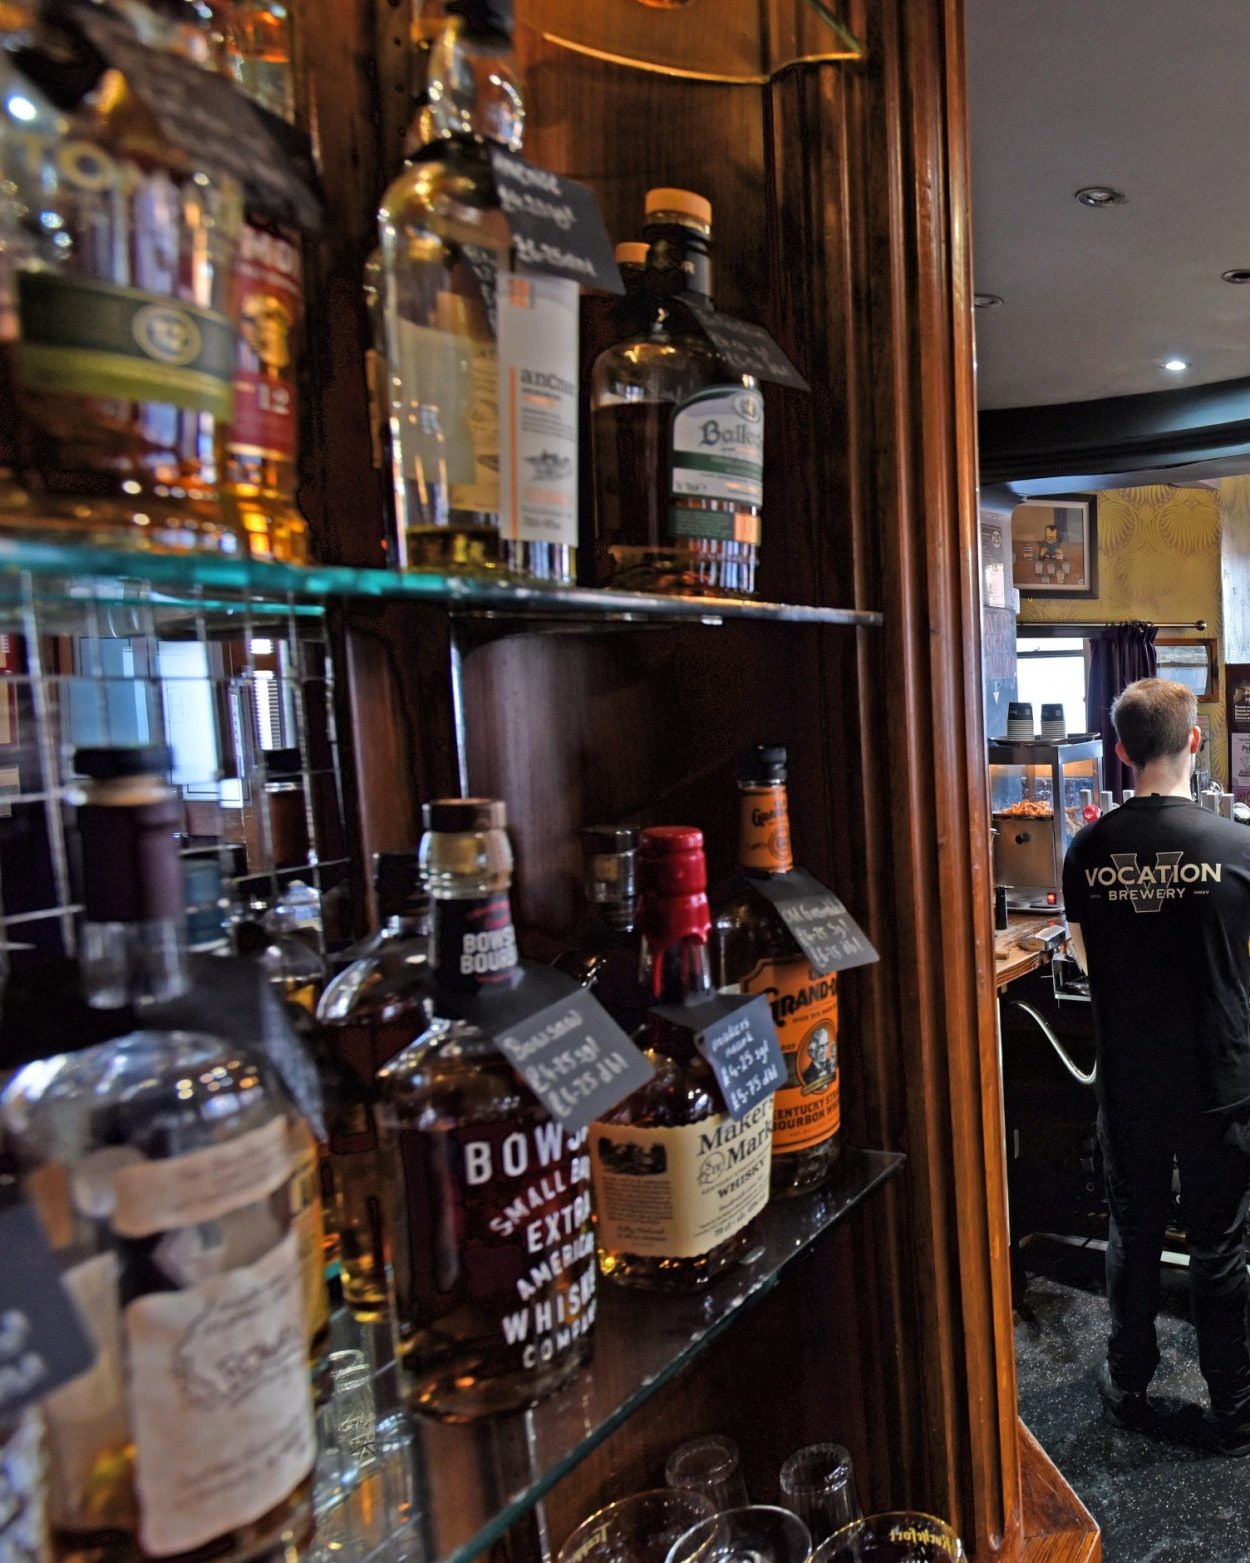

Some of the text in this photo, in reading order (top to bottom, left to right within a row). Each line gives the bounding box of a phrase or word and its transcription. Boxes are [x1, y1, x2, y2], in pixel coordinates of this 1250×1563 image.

[1085, 863, 1222, 887] VOCATION
[1108, 887, 1186, 901] BREWERY
[726, 1120, 775, 1172] Mark
[717, 1159, 766, 1199] WHISKY
[489, 1169, 567, 1237] SMALL
